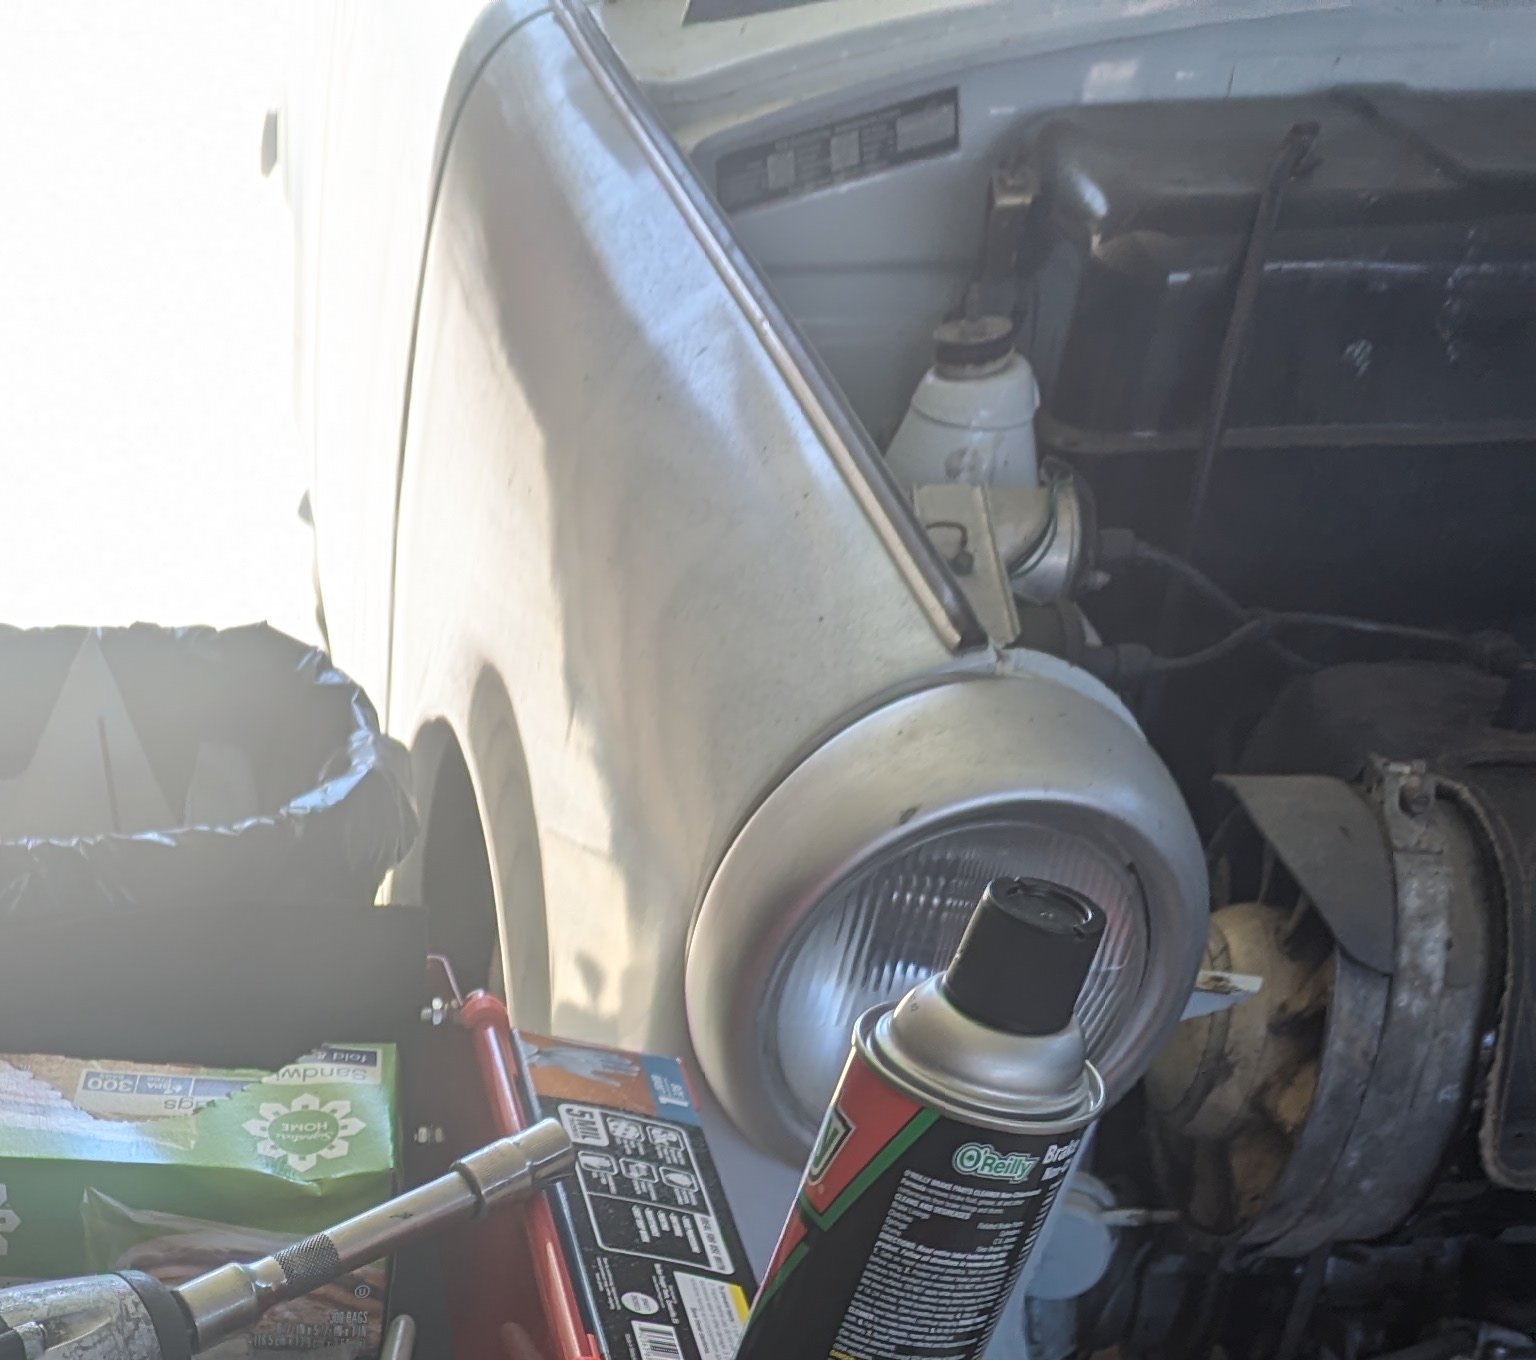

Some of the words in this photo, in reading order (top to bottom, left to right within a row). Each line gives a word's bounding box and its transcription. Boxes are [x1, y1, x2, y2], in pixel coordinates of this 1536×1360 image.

[87, 1079, 133, 1091] 300
[281, 1121, 328, 1131] HOME
[576, 1119, 601, 1140] MIL
[276, 1130, 333, 1142] Signature
[959, 1146, 1034, 1178] O'Reilly
[346, 1311, 368, 1324] BAGS
